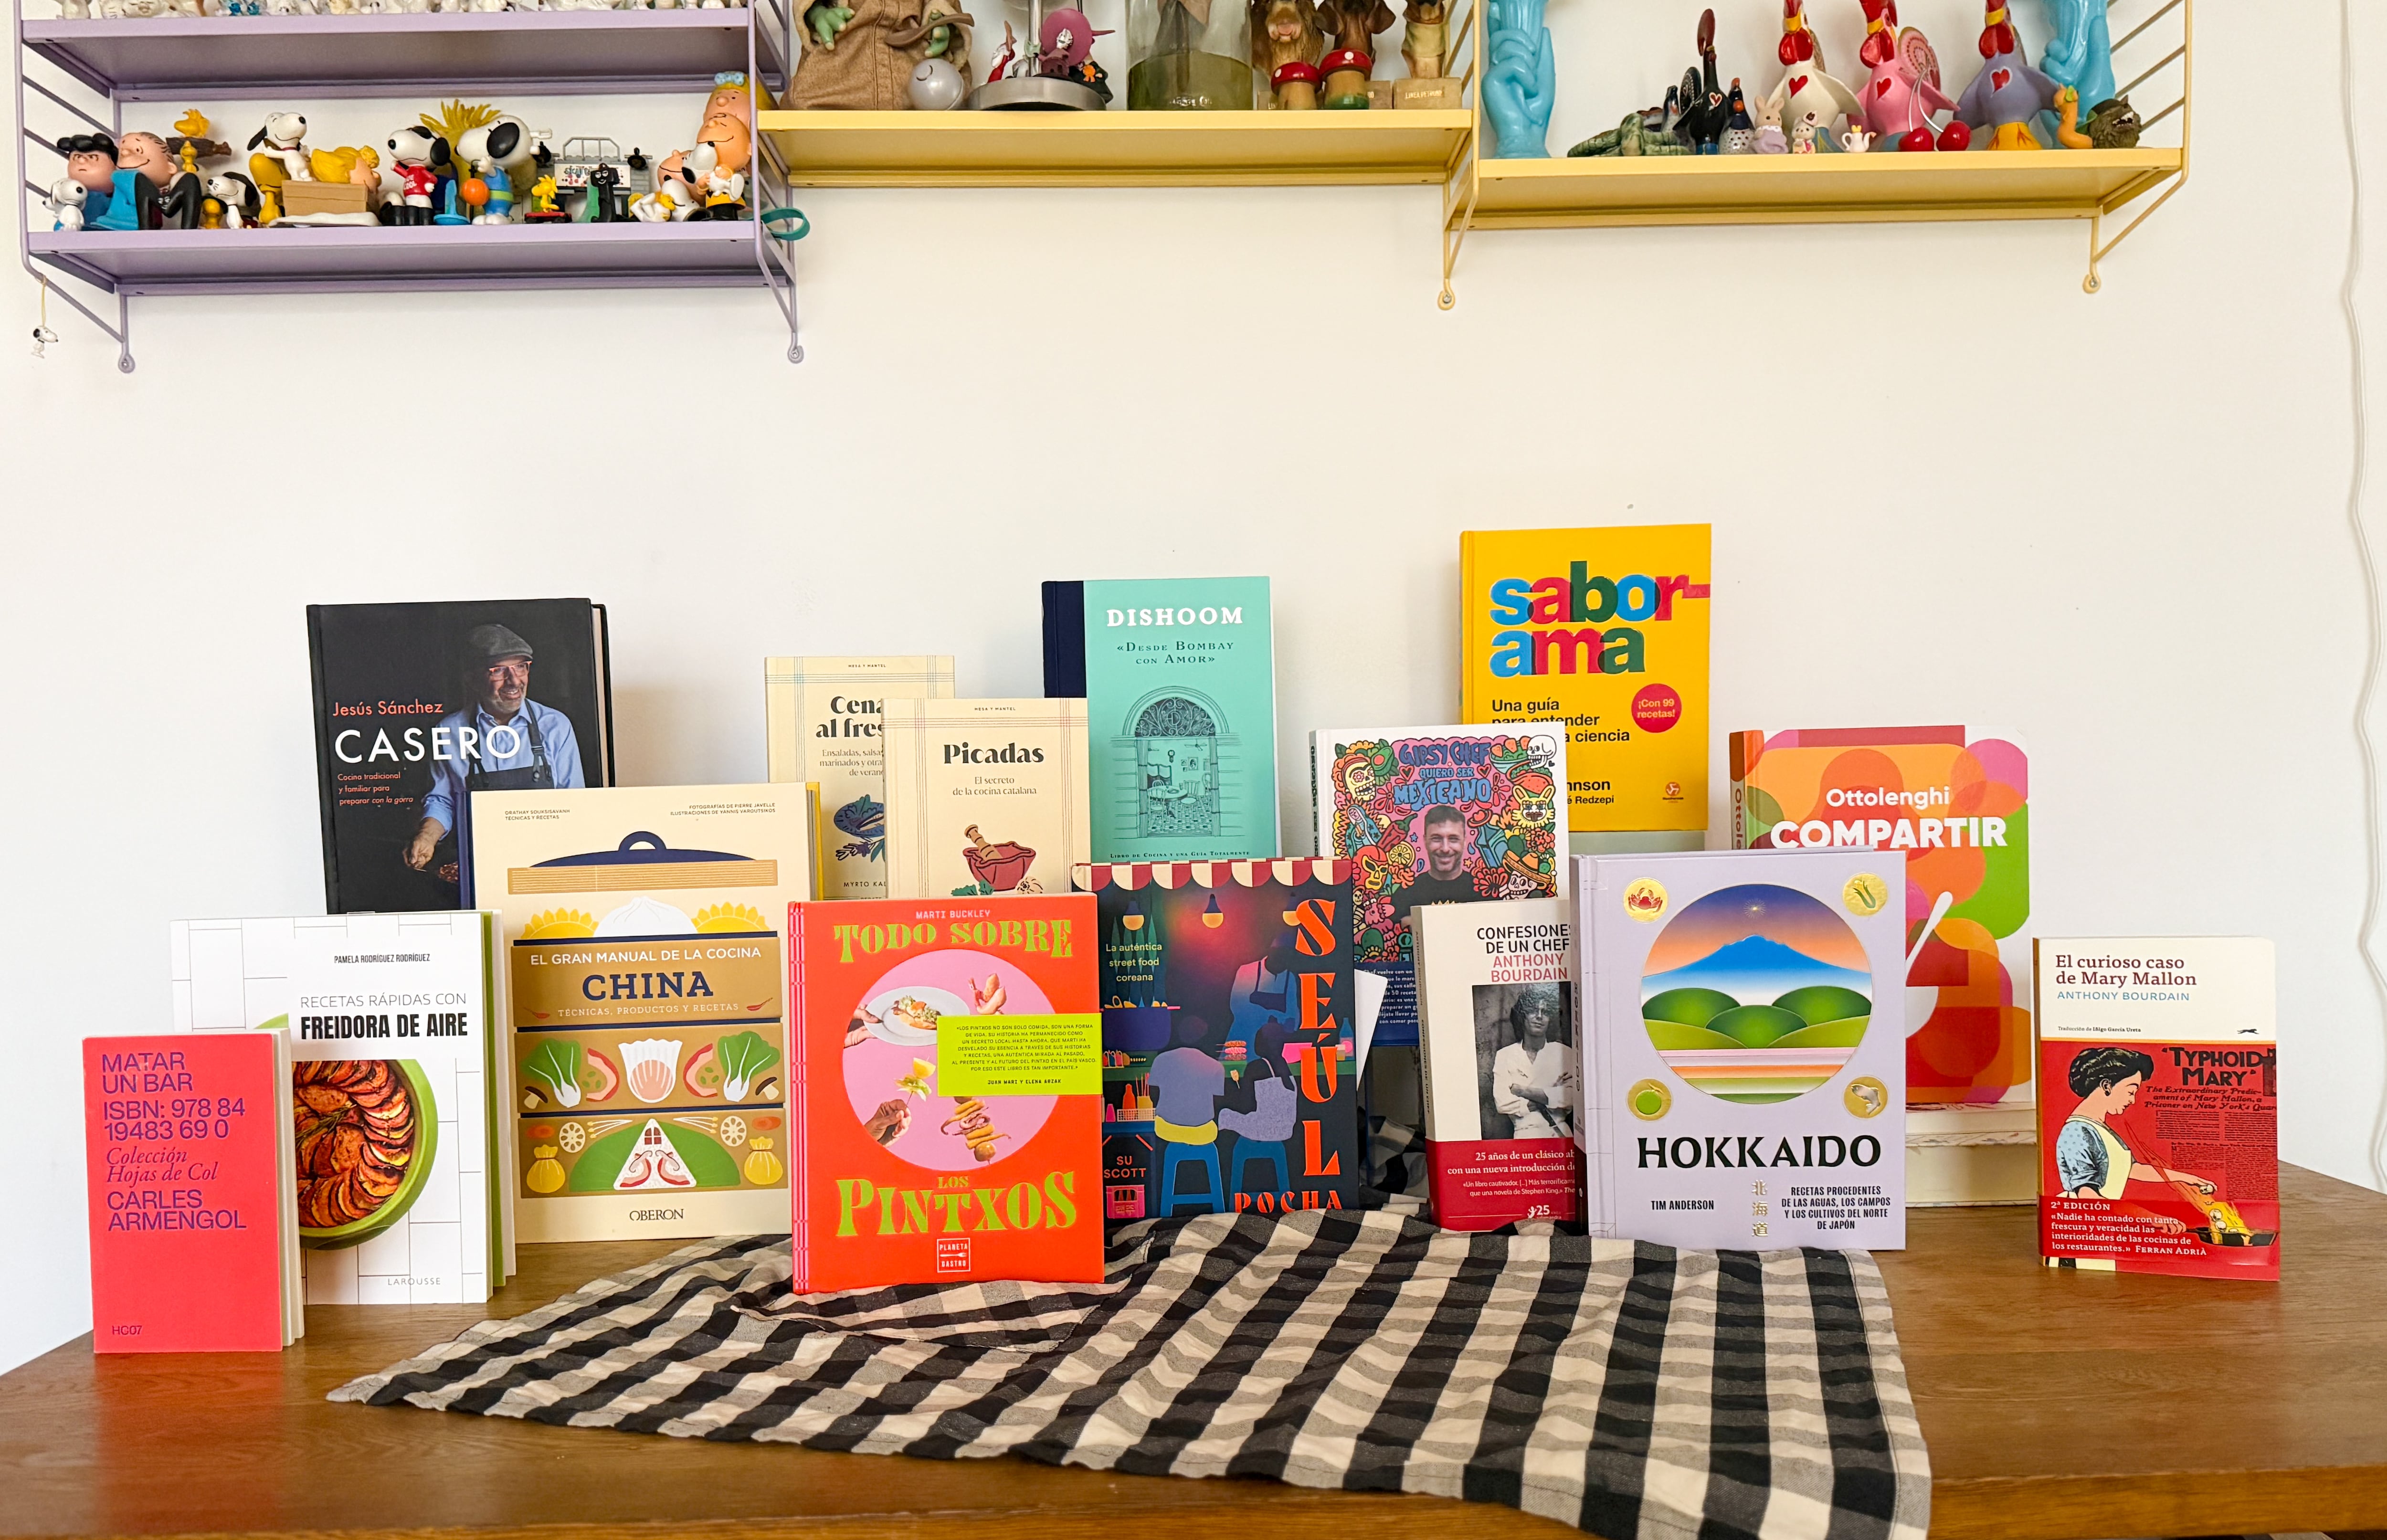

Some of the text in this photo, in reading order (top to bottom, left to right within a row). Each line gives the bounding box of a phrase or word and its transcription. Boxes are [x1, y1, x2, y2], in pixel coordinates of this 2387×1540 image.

[1107, 607, 1243, 627] DISHOOM
[1489, 627, 1645, 677] ama
[333, 699, 444, 716] Jesús Sánchez
[1492, 699, 1559, 714] Una guía
[1638, 700, 1660, 708] ¡Con
[1637, 709, 1675, 718] recetas!
[1575, 730, 1630, 742] ciencia
[335, 725, 520, 763] CASERO
[822, 748, 861, 758] Ensaladas,
[944, 742, 1044, 765] Picadas
[1399, 741, 1491, 766] GIPSY CHEF
[1419, 767, 1474, 778] QUIERO SER
[974, 776, 982, 784] El
[965, 787, 972, 795] la
[974, 787, 1001, 795] cocina
[1003, 786, 1036, 795] catalana
[1575, 795, 1614, 805] Redzepi
[1826, 786, 1949, 810] Ottolenghi
[1771, 816, 2008, 848] COMPARTIR
[916, 909, 990, 919] MARTI BUCKLEY
[834, 919, 1072, 963] TODO SOBRE
[1106, 943, 1162, 952] La auténtica
[1486, 939, 1569, 953] DE UN CHEF
[335, 952, 430, 964] PAMELA RODRÍGUEZ RODRÍGUEZ
[531, 947, 761, 965] EL GRAN MANUAL DE LA COCINA
[1109, 957, 1159, 967] street food
[1493, 953, 1563, 968] ANTHONY
[2056, 955, 2185, 969] El curioso caso
[1117, 974, 1153, 982] coreana
[1491, 967, 1567, 982] BOURDAIN
[2056, 971, 2197, 988] de Mary Mallon
[582, 971, 713, 1001] CHINA
[301, 995, 364, 1008] RECETAS
[370, 992, 431, 1006] RÁPIDAS
[2058, 992, 2189, 1001] ANTHONY BOURDAIN
[558, 1006, 613, 1017] TÉCNICAS,
[617, 1005, 679, 1014] PRODUCTOS
[301, 1013, 467, 1040] FREIDORA DE AIRE
[103, 1052, 185, 1073] MATAR
[103, 1073, 192, 1094] UN BAR
[105, 1098, 245, 1120] ISBN: 978 84
[105, 1119, 229, 1141] 19483 69 0
[106, 1147, 187, 1165] Colección
[1475, 1152, 1486, 1160] 25
[1488, 1151, 1508, 1160] años
[1510, 1151, 1520, 1160] de
[1535, 1150, 1563, 1159] clásico
[1637, 1135, 1881, 1169] HOKKAIDO
[1116, 1156, 1132, 1165] SU
[1510, 1163, 1565, 1172] introducción
[106, 1162, 217, 1188] Hojas de Col
[1104, 1168, 1146, 1179] SCOTT
[938, 1176, 969, 1188] LOS
[1791, 1186, 1881, 1196] RECETAS PROCEDENTES
[107, 1189, 202, 1211] CARLES
[835, 1171, 1077, 1236] PINTXOS
[1235, 1191, 1342, 1213] POCHA
[1651, 1200, 1714, 1210] TIM ANDERSON
[1782, 1197, 1891, 1208] DE LAS AGUAS, LOS CAMPOS
[2064, 1202, 2110, 1211] EDICIÓN
[630, 1208, 684, 1222] OBERON
[1752, 1180, 1768, 1237] 北海道
[1785, 1208, 1888, 1218] Y LOS CULTIVOS DEL NORTE
[108, 1209, 246, 1232] ARMENGOL
[1817, 1219, 1855, 1229] DE JAPÓN
[2098, 1214, 2134, 1223] contado
[2155, 1216, 2178, 1224] tanta
[2052, 1242, 2065, 1250] los
[942, 1259, 966, 1268] GASTRO
[388, 1277, 441, 1285] LAROUSSE
